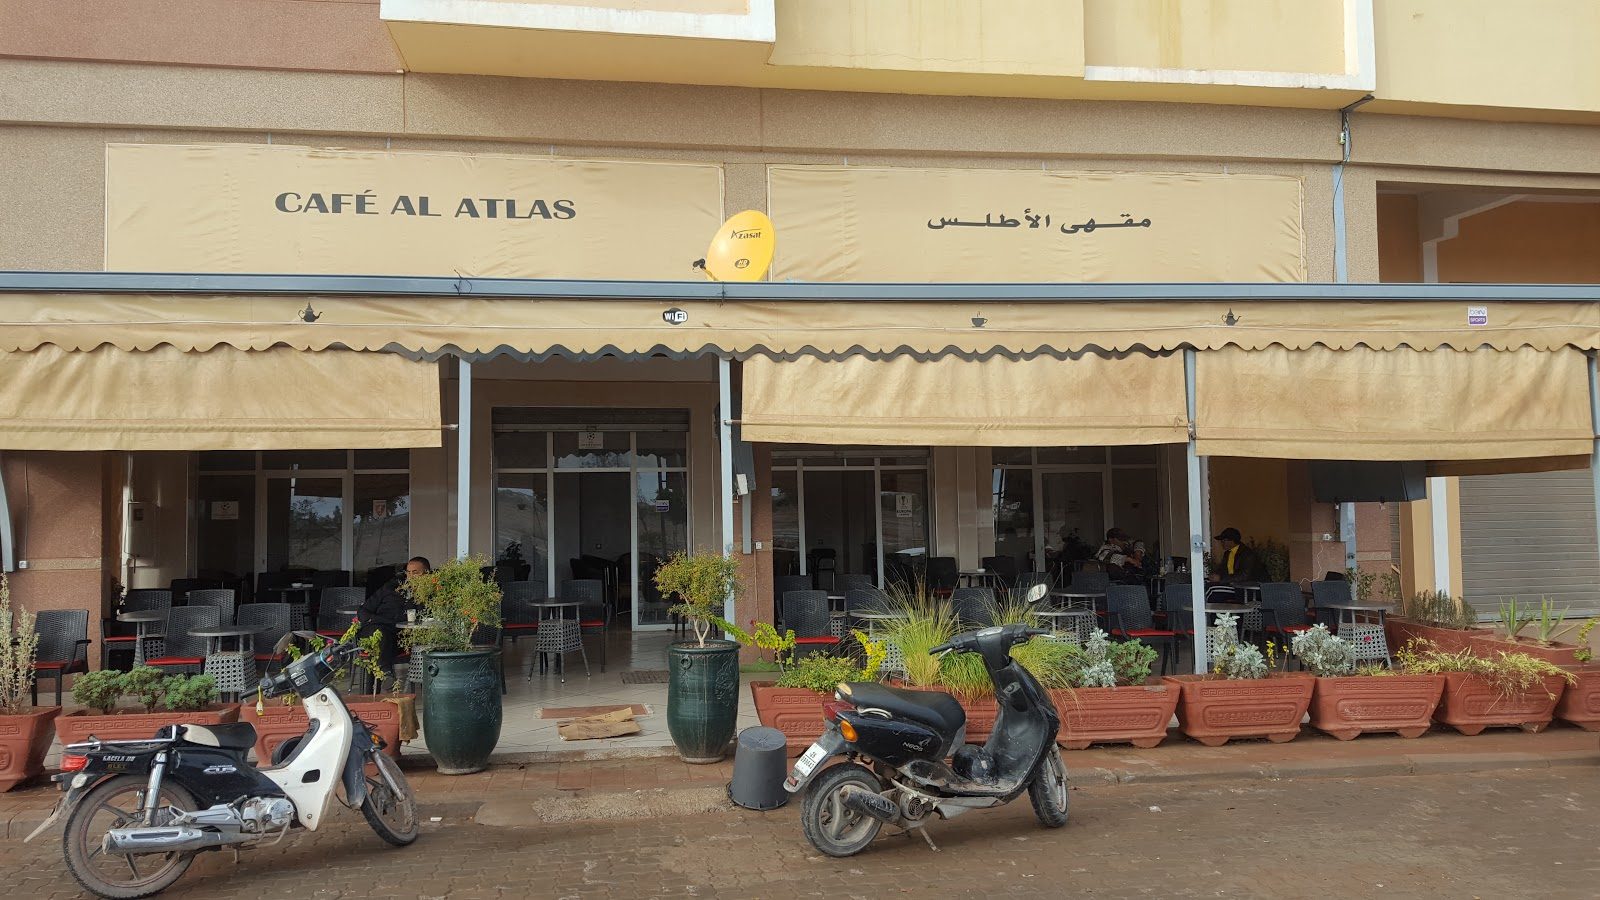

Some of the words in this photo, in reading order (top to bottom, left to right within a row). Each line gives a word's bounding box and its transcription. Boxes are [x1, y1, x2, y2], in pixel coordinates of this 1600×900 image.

[275, 189, 379, 215] CAFÉ
[390, 195, 442, 217] AL
[454, 198, 577, 220] ATLAS
[927, 208, 1051, 230] الأطلس
[1060, 213, 1152, 234] مقهى
[731, 229, 762, 239] Azasat
